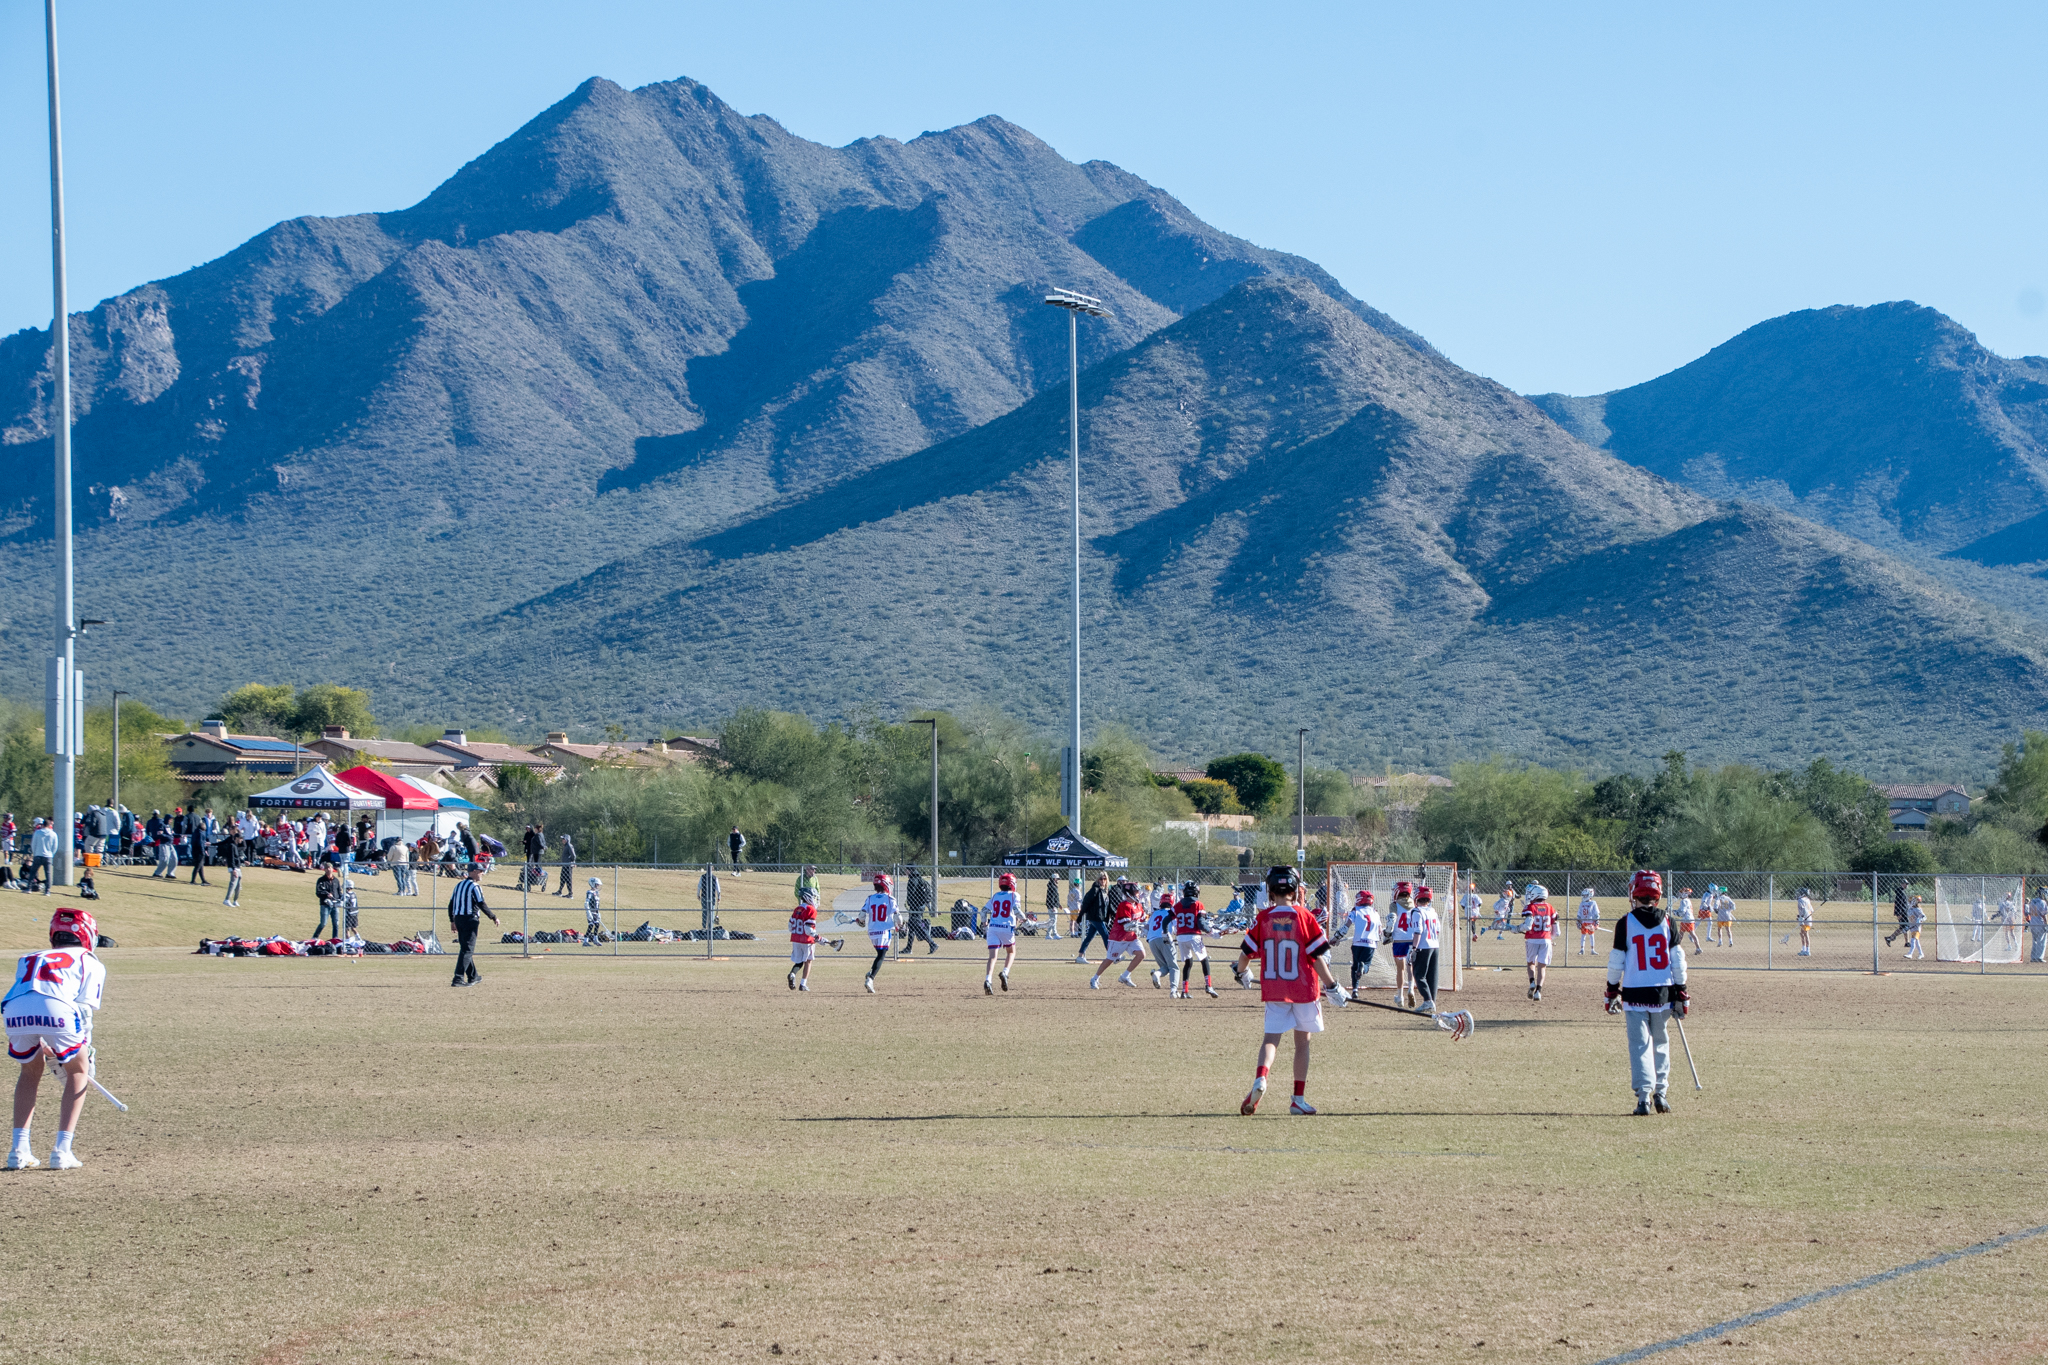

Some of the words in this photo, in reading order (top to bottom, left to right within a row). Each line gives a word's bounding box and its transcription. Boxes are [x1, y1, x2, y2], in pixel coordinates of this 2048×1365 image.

[870, 904, 888, 922] 10
[992, 900, 1011, 918] 99
[791, 918, 804, 935] 28
[1176, 912, 1195, 929] 33
[1397, 912, 1413, 932] 4
[1533, 915, 1551, 932] 92
[1263, 938, 1300, 981] 10
[1632, 933, 1669, 971] 13
[21, 952, 75, 985] 12
[6, 1015, 65, 1028] NATIONALS
